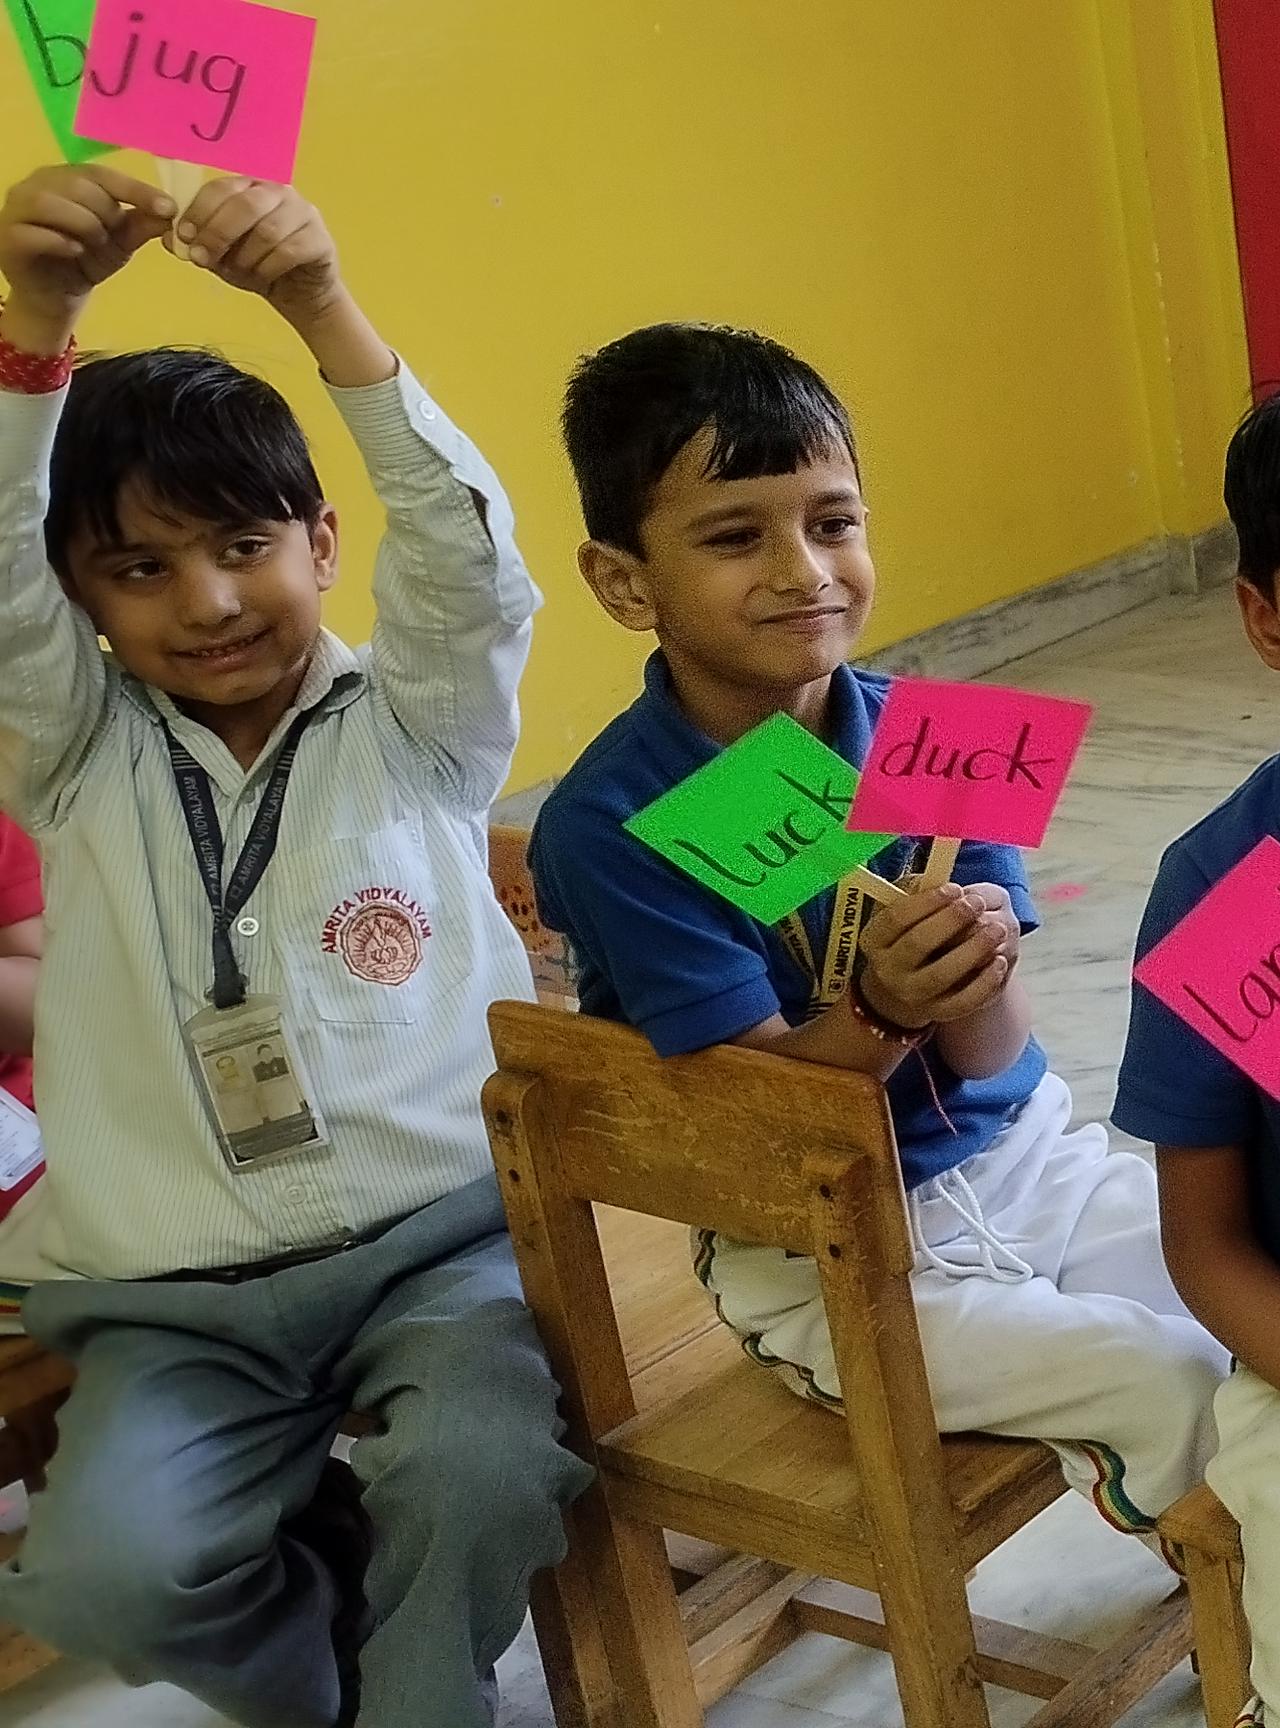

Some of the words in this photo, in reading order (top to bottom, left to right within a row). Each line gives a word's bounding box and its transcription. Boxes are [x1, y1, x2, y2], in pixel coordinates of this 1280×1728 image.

[91, 12, 247, 142] jug
[879, 717, 1056, 790] duck
[674, 771, 853, 887] luck
[322, 899, 356, 954] AMRITA
[354, 887, 433, 938] VIDYALAYAM
[834, 930, 853, 977] AMRITA
